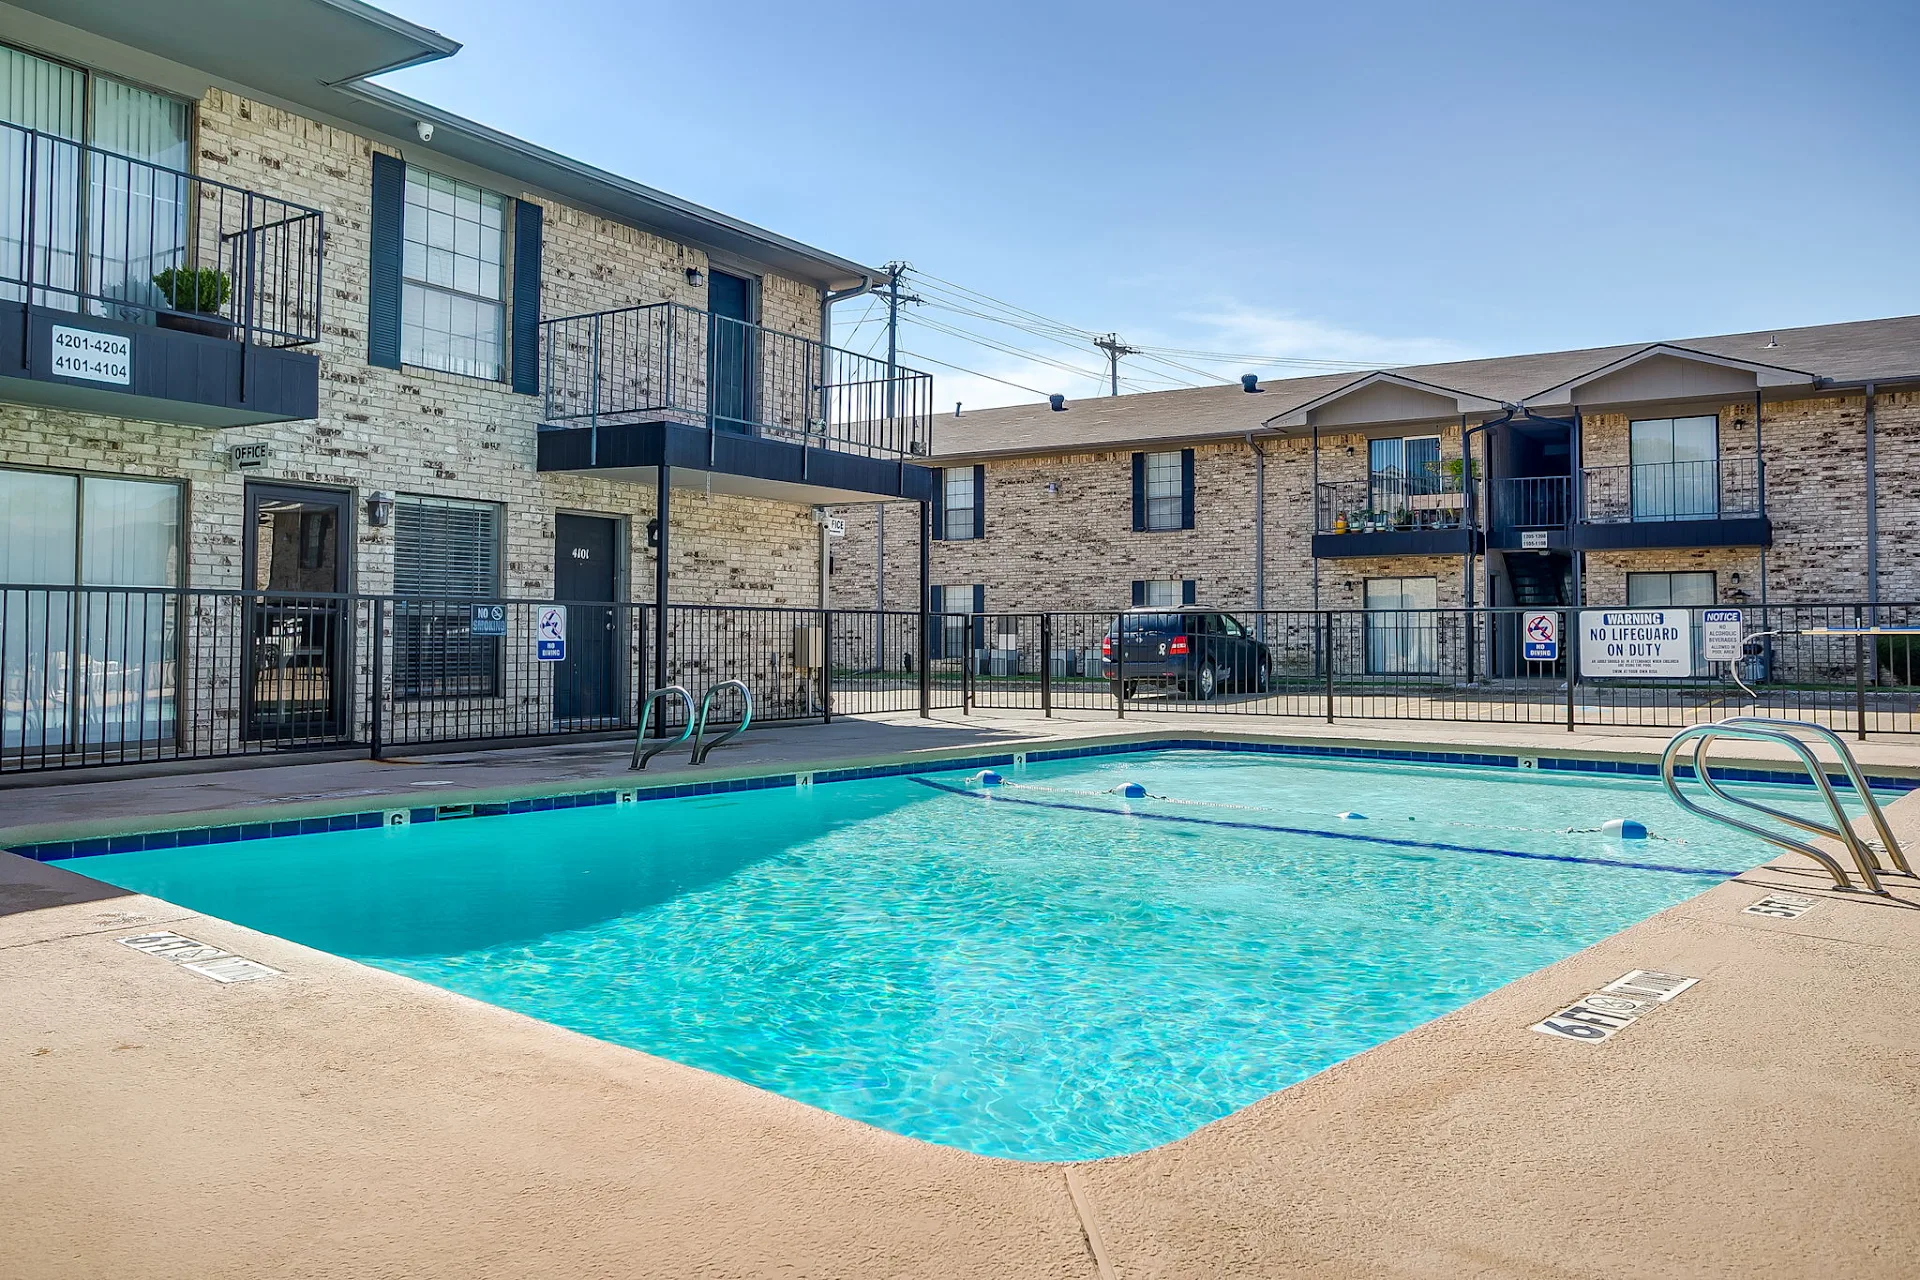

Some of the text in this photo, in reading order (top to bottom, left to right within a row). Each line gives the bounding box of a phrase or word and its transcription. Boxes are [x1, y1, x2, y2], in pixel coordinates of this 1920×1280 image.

[56, 333, 127, 356] 4201-4204
[55, 356, 127, 378] 4101-4104
[235, 445, 266, 460] OFFICE
[831, 519, 844, 530] FICE
[572, 547, 590, 560] 4101
[477, 607, 489, 619] NO
[1607, 613, 1661, 625] WARNING
[1707, 612, 1738, 622] NOTICE
[473, 620, 505, 632] SMOKING
[1590, 628, 1678, 641] NO LIFEGUARD
[1607, 644, 1661, 657] ON DUTY
[622, 793, 632, 803] 5
